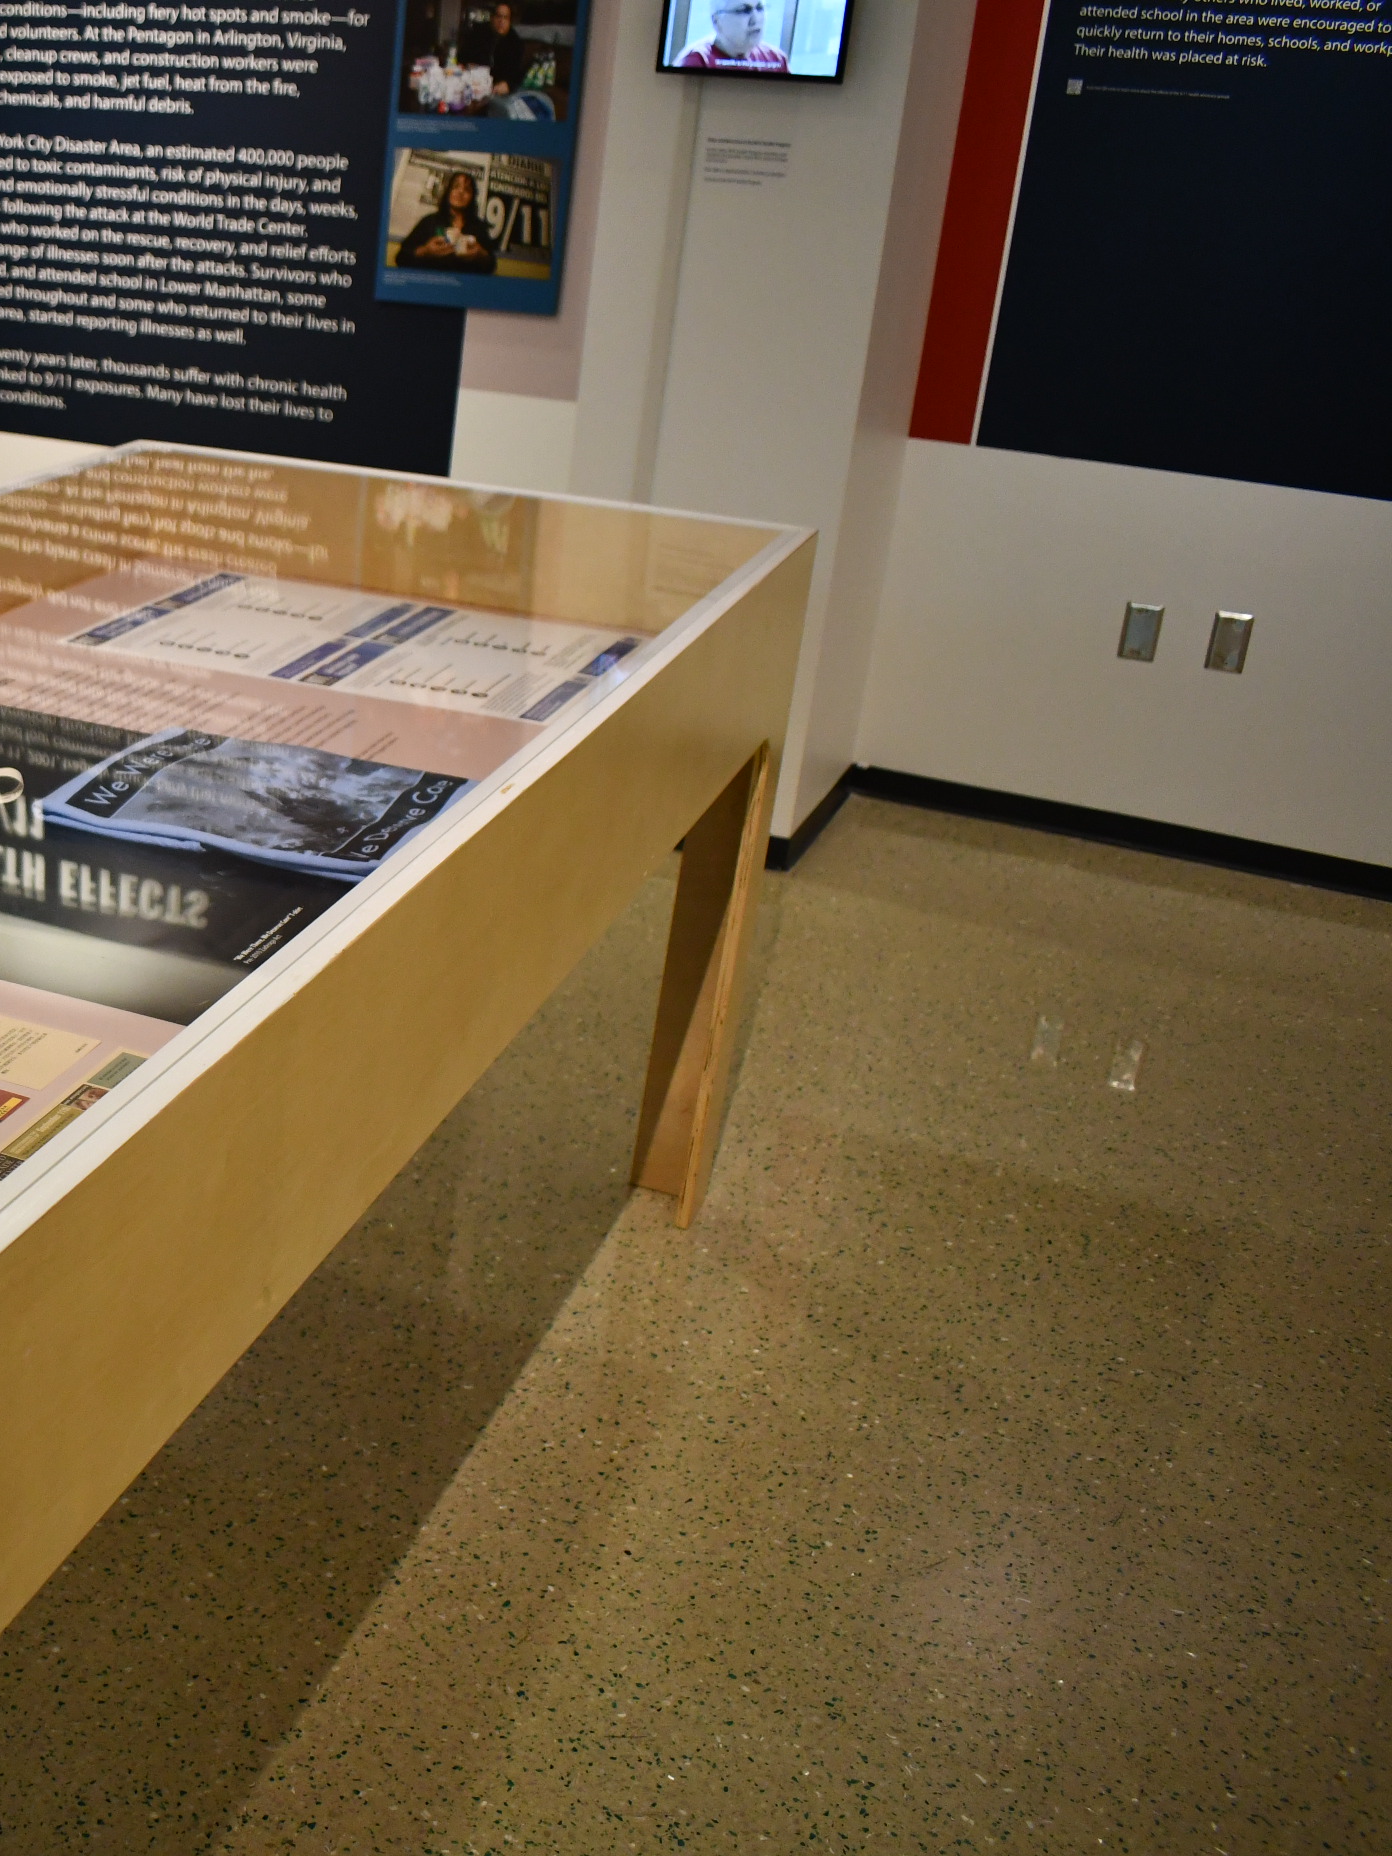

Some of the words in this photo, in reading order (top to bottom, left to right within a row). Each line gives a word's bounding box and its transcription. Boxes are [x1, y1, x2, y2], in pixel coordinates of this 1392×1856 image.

[147, 4, 179, 26] fiery
[180, 5, 206, 22] hot
[208, 8, 248, 27] spots
[249, 8, 279, 24] and
[1079, 6, 1137, 18] attended
[1141, 8, 1183, 21] school
[1186, 11, 1198, 22] in
[1201, 12, 1222, 23] the
[1226, 15, 1253, 25] area
[1258, 17, 1289, 27] were
[1293, 19, 1374, 34] encouraged
[1377, 22, 1392, 33] to
[1310, 0, 1363, 12] worked,
[1367, 2, 1381, 12] or
[9, 24, 81, 42] volunteers.
[83, 26, 100, 42] At
[101, 26, 125, 43] the
[127, 27, 193, 49] Pentagon
[195, 31, 210, 46] in
[213, 30, 284, 52] Arlington,
[286, 32, 346, 54] Virginia,
[1076, 24, 1121, 40] quickly
[1124, 29, 1164, 41] return
[1167, 30, 1181, 41] to
[1184, 30, 1215, 43] their
[1217, 32, 1264, 47] homes,
[1268, 36, 1320, 51] schools,
[1323, 40, 1350, 52] and
[4, 46, 57, 68] cleanup
[59, 52, 101, 68] crews,
[102, 50, 129, 66] and
[131, 53, 219, 70] construction
[221, 54, 279, 72] workers
[281, 60, 318, 73] were
[1074, 43, 1105, 57] Their
[1108, 46, 1148, 60] health
[1152, 52, 1176, 62] was
[1178, 50, 1222, 65] placed
[1225, 54, 1238, 66] at
[1241, 54, 1267, 68] risk.
[25, 134, 53, 157] City
[53, 136, 107, 155] Disaster
[108, 139, 143, 160] Area,
[145, 146, 163, 158] an
[164, 145, 235, 163] estimated
[237, 147, 294, 167] 400,000
[295, 152, 349, 173] people
[487, 196, 549, 252] 9/11
[32, 352, 66, 368] years
[67, 353, 99, 373] later,
[101, 359, 170, 379] thousands
[172, 368, 210, 384] suffer
[213, 373, 244, 388] with
[246, 376, 298, 395] chronic
[300, 382, 347, 401] health
[27, 373, 42, 387] to
[43, 373, 72, 390] 9/11
[73, 379, 143, 399] exposures.
[145, 386, 183, 408] Many
[185, 391, 217, 408] have
[220, 395, 245, 411] lost
[247, 399, 282, 416] their
[284, 403, 314, 420] lives
[317, 408, 333, 422] to
[84, 779, 130, 806] We
